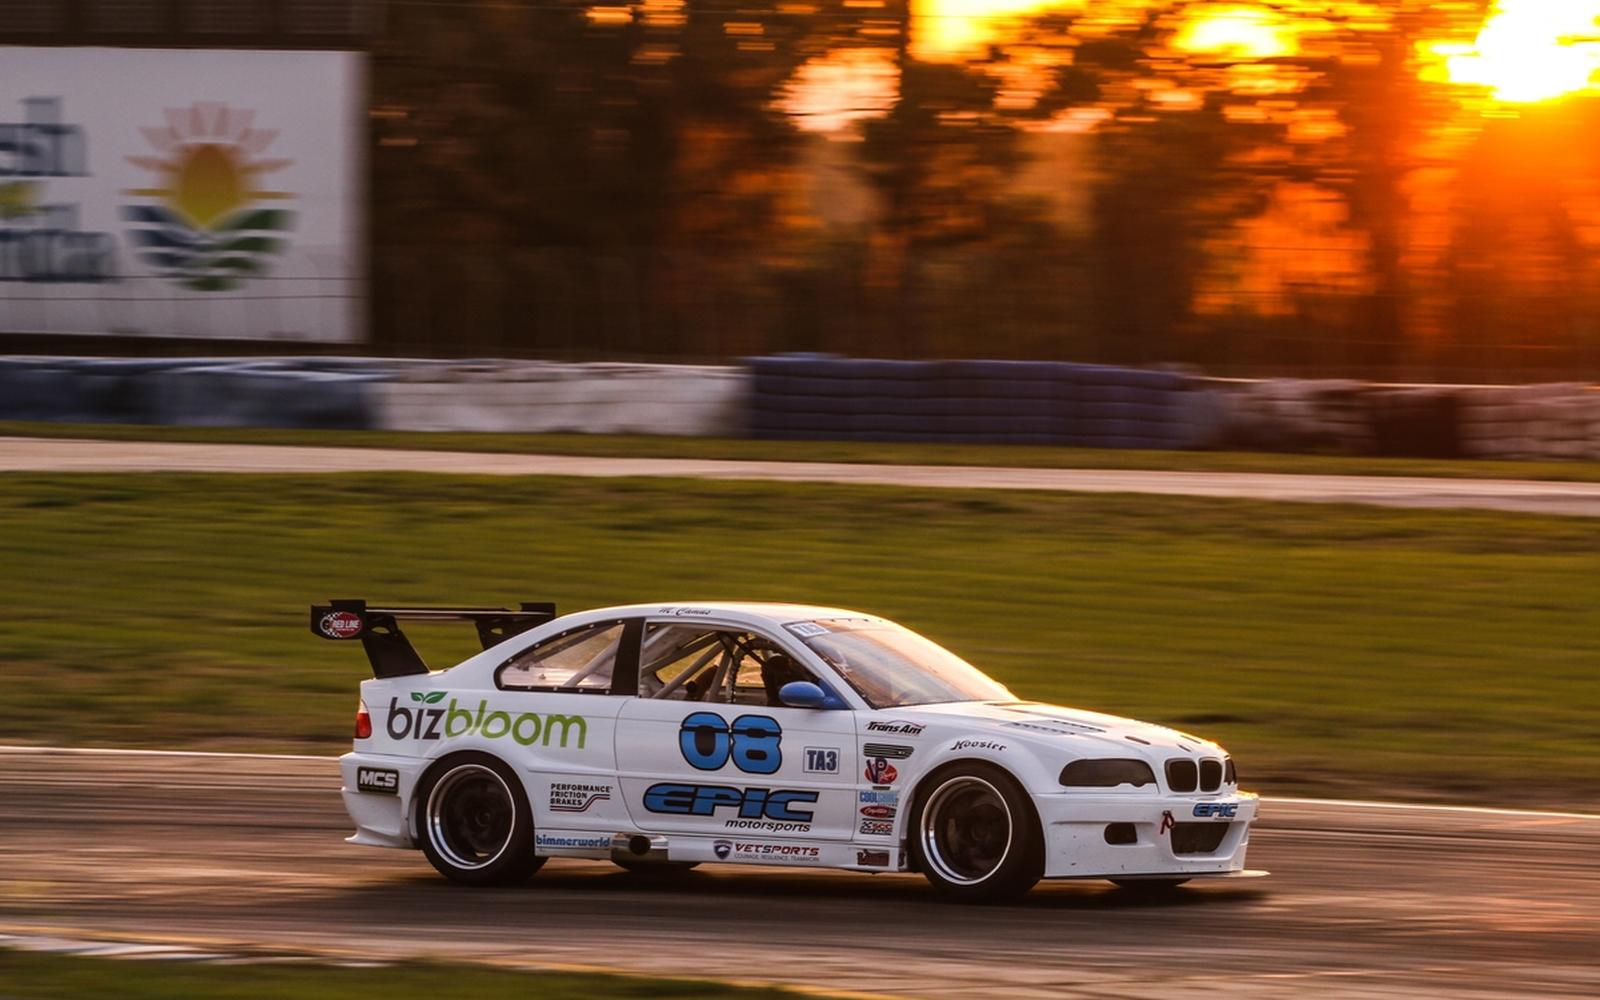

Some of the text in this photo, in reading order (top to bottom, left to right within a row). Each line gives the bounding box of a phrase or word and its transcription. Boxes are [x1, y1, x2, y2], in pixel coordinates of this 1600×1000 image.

[387, 695, 588, 749] bizbloom
[867, 721, 922, 735] Trans Am
[679, 711, 783, 775] 08
[806, 750, 838, 771] TA3
[360, 770, 397, 787] MCS
[550, 783, 611, 793] PERFORMANCE
[550, 791, 587, 799] FRICTION
[550, 798, 583, 806] BRAKES
[642, 782, 820, 823] EPIC
[1192, 803, 1239, 817] EPIC
[725, 819, 811, 832] motorsports
[536, 835, 610, 847] bimmerworld
[735, 843, 820, 856] VETSPORTS
